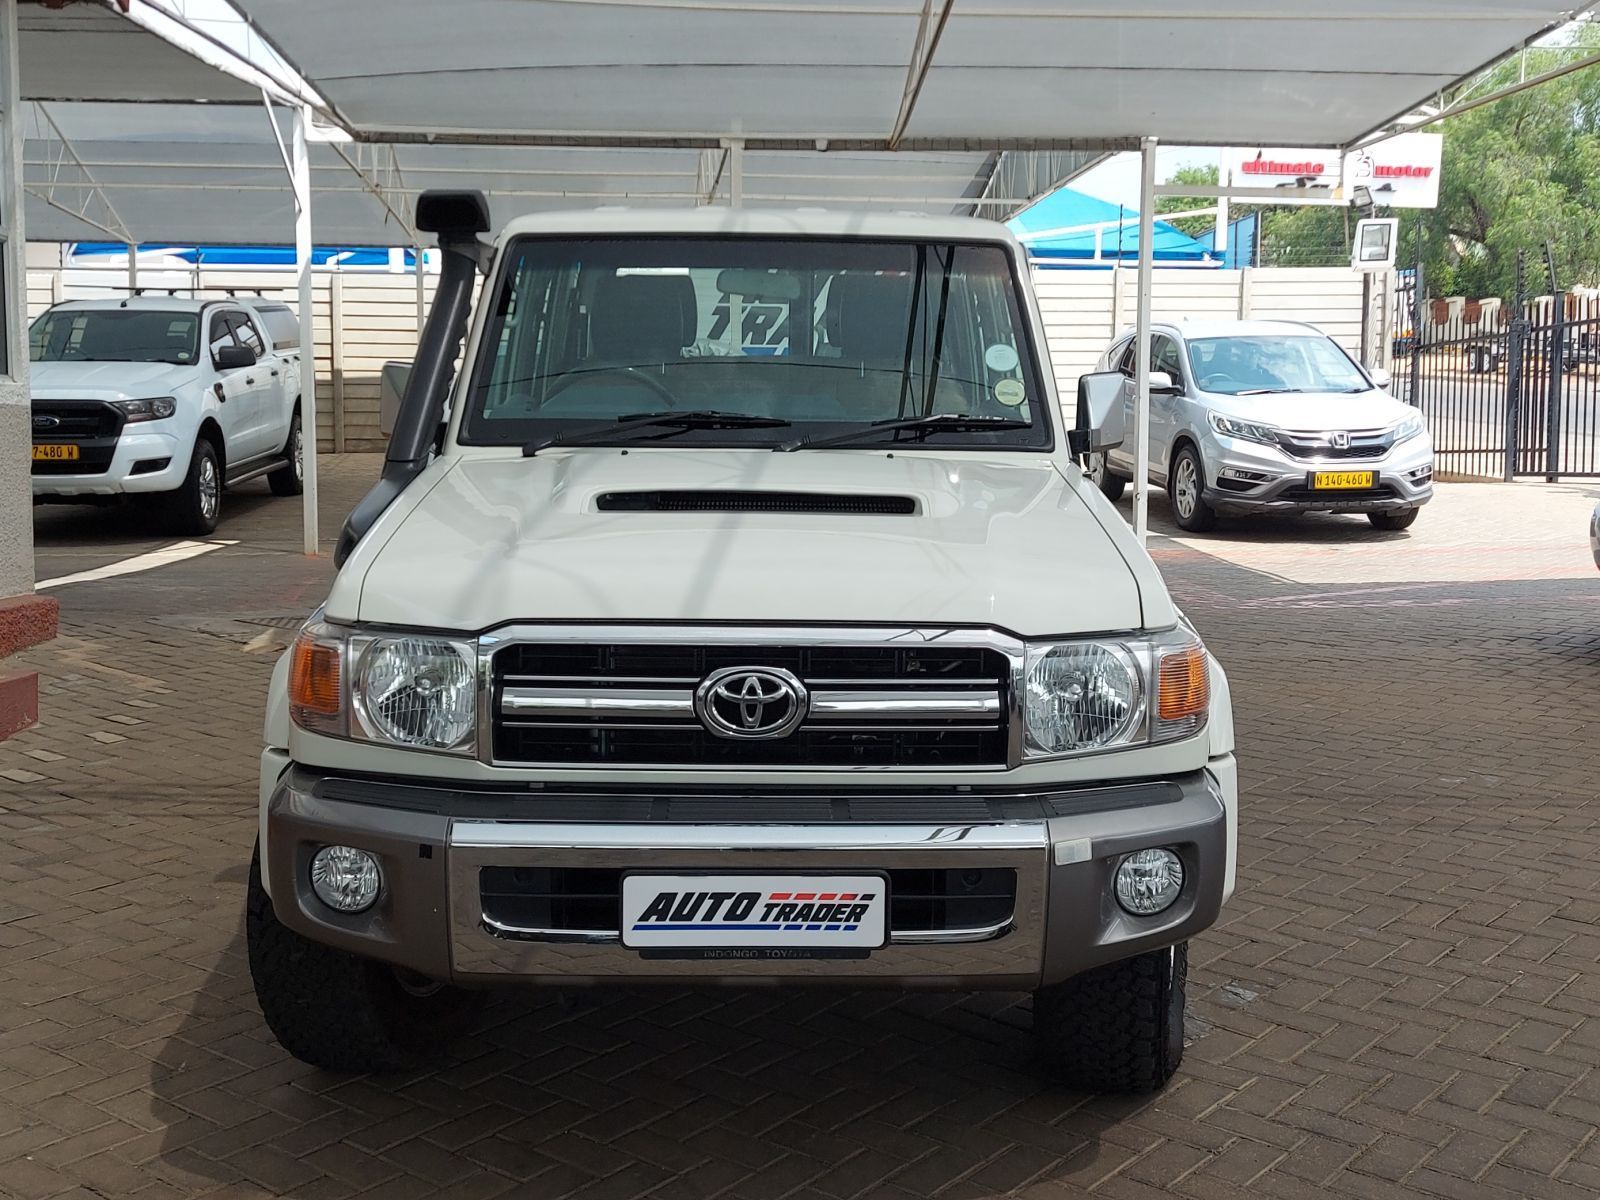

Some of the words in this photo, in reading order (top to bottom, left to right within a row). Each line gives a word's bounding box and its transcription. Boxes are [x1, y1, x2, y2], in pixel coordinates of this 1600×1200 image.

[1375, 165, 1433, 178] motor
[1316, 475, 1323, 486] N
[1325, 474, 1363, 486] 140-460
[1365, 474, 1371, 485] W
[637, 892, 762, 922] AUTO
[759, 903, 870, 922] TRADER
